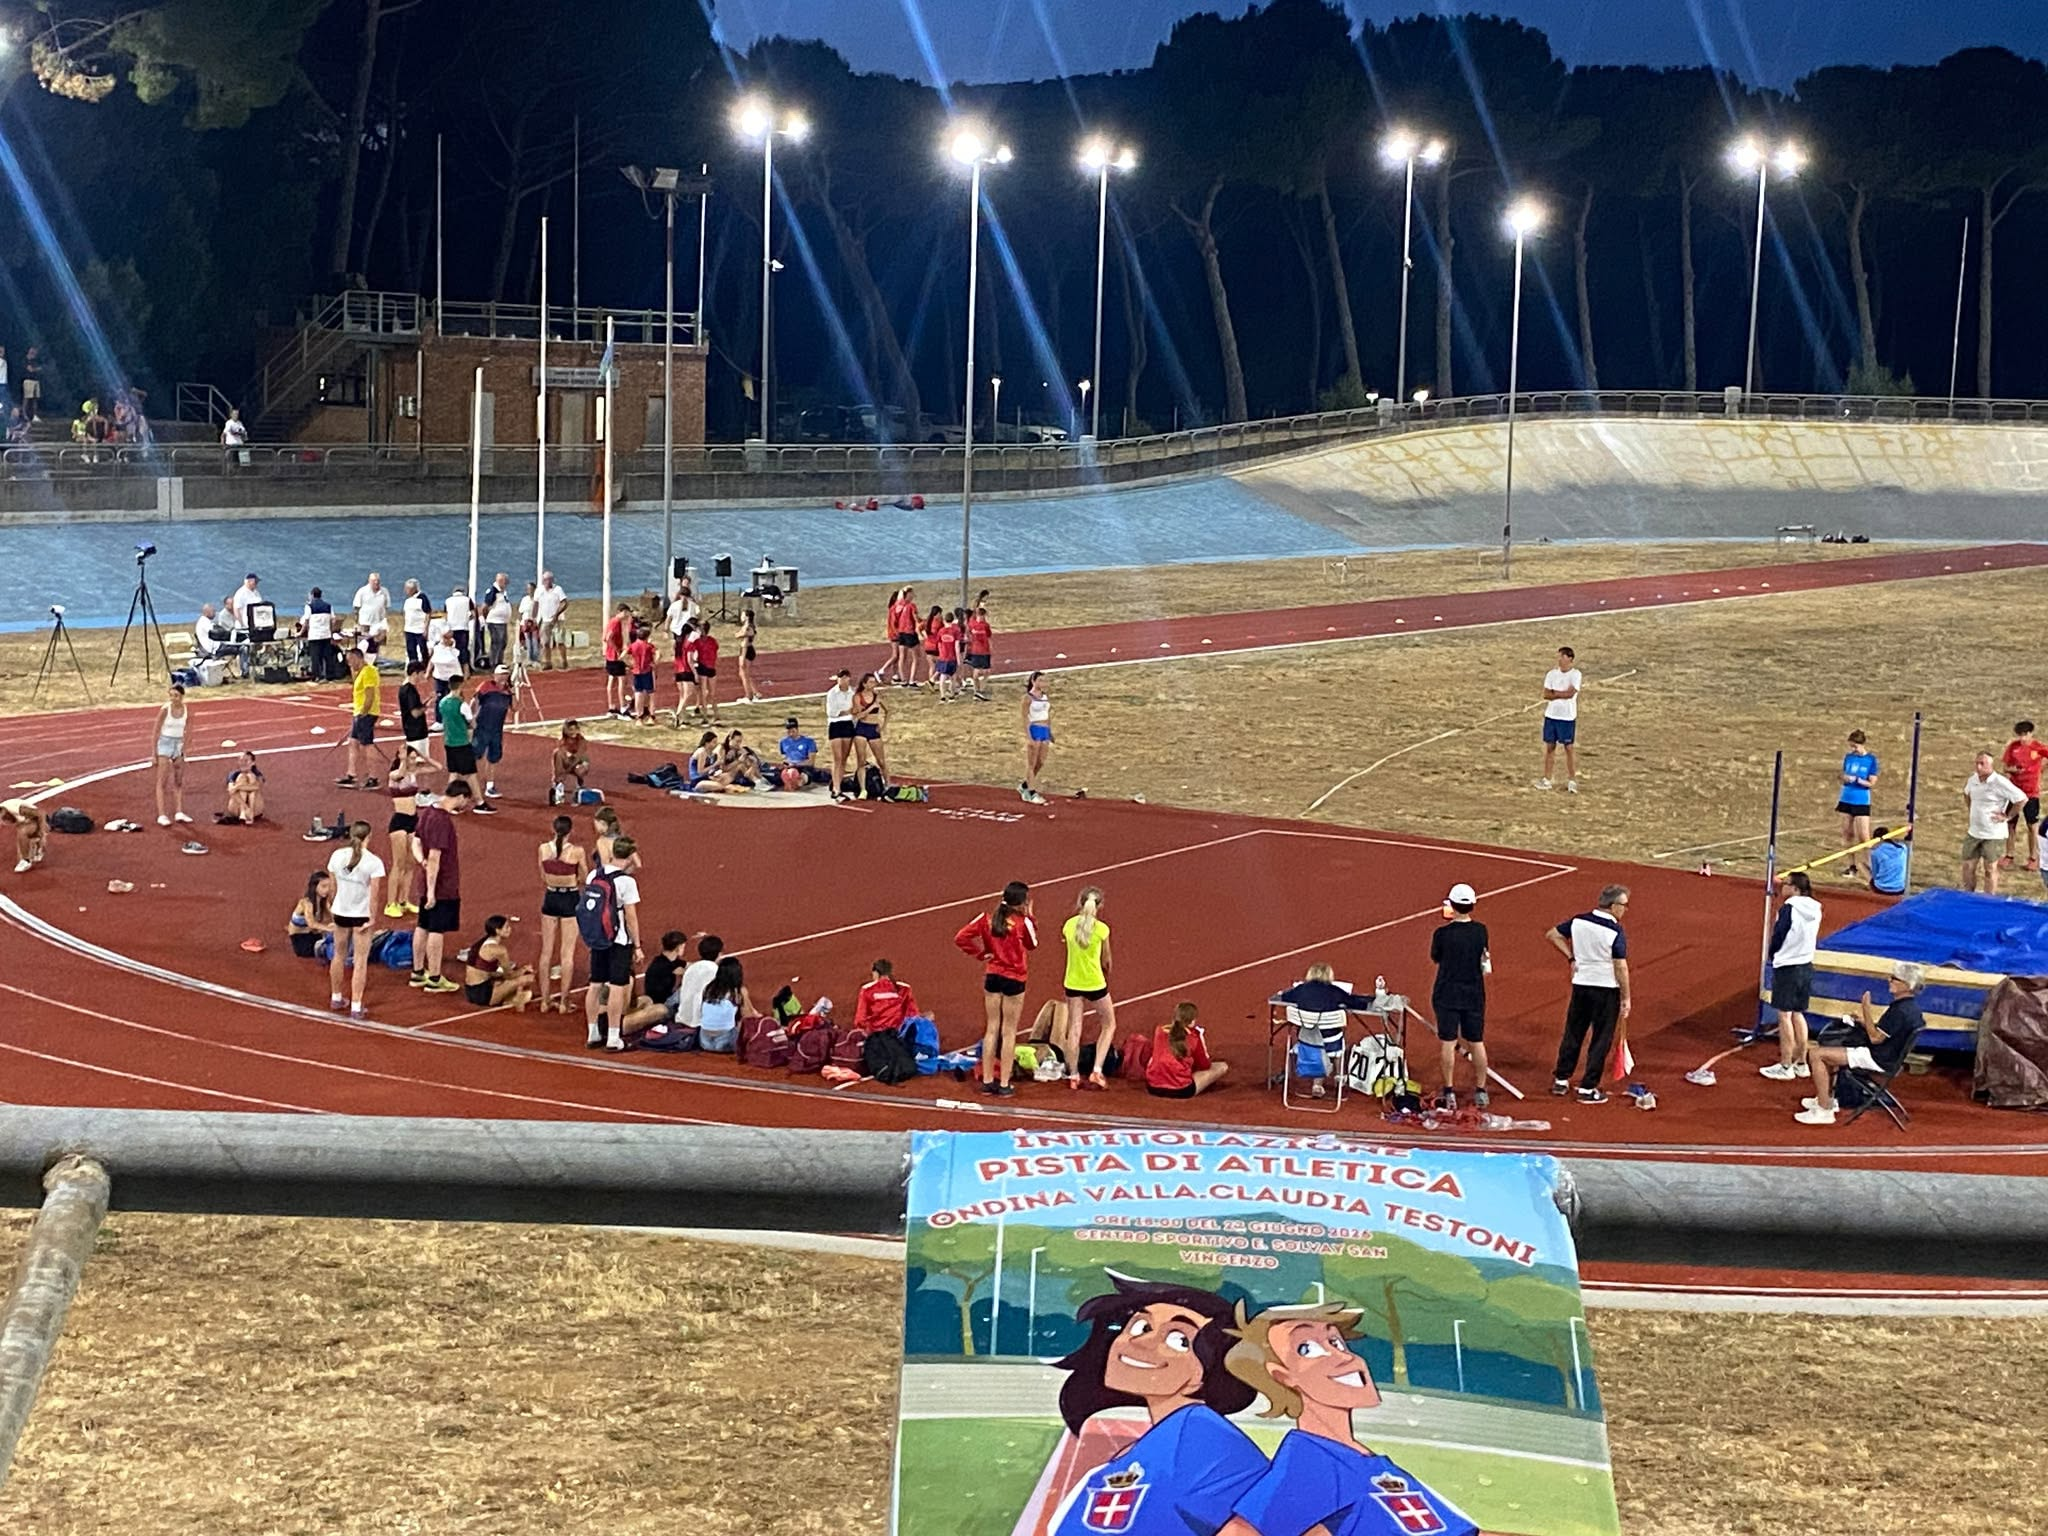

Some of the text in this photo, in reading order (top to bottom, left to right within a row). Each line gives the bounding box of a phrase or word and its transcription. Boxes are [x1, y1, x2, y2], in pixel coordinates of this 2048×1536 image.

[1350, 1051, 1370, 1081] 20
[979, 1154, 1462, 1198] PISTA DI ATLETICA
[929, 1190, 1077, 1228] ONDINA
[1384, 1203, 1538, 1265] TESTONI
[1186, 1218, 1220, 1231] DEL
[1249, 1221, 1324, 1236] GIUGNO
[1075, 1229, 1149, 1242] CENTRO
[1152, 1231, 1248, 1249] SPORTIVO
[1272, 1239, 1344, 1255] SOLVAY
[1348, 1245, 1387, 1258] SAN
[1180, 1250, 1277, 1268] VINCENZO
